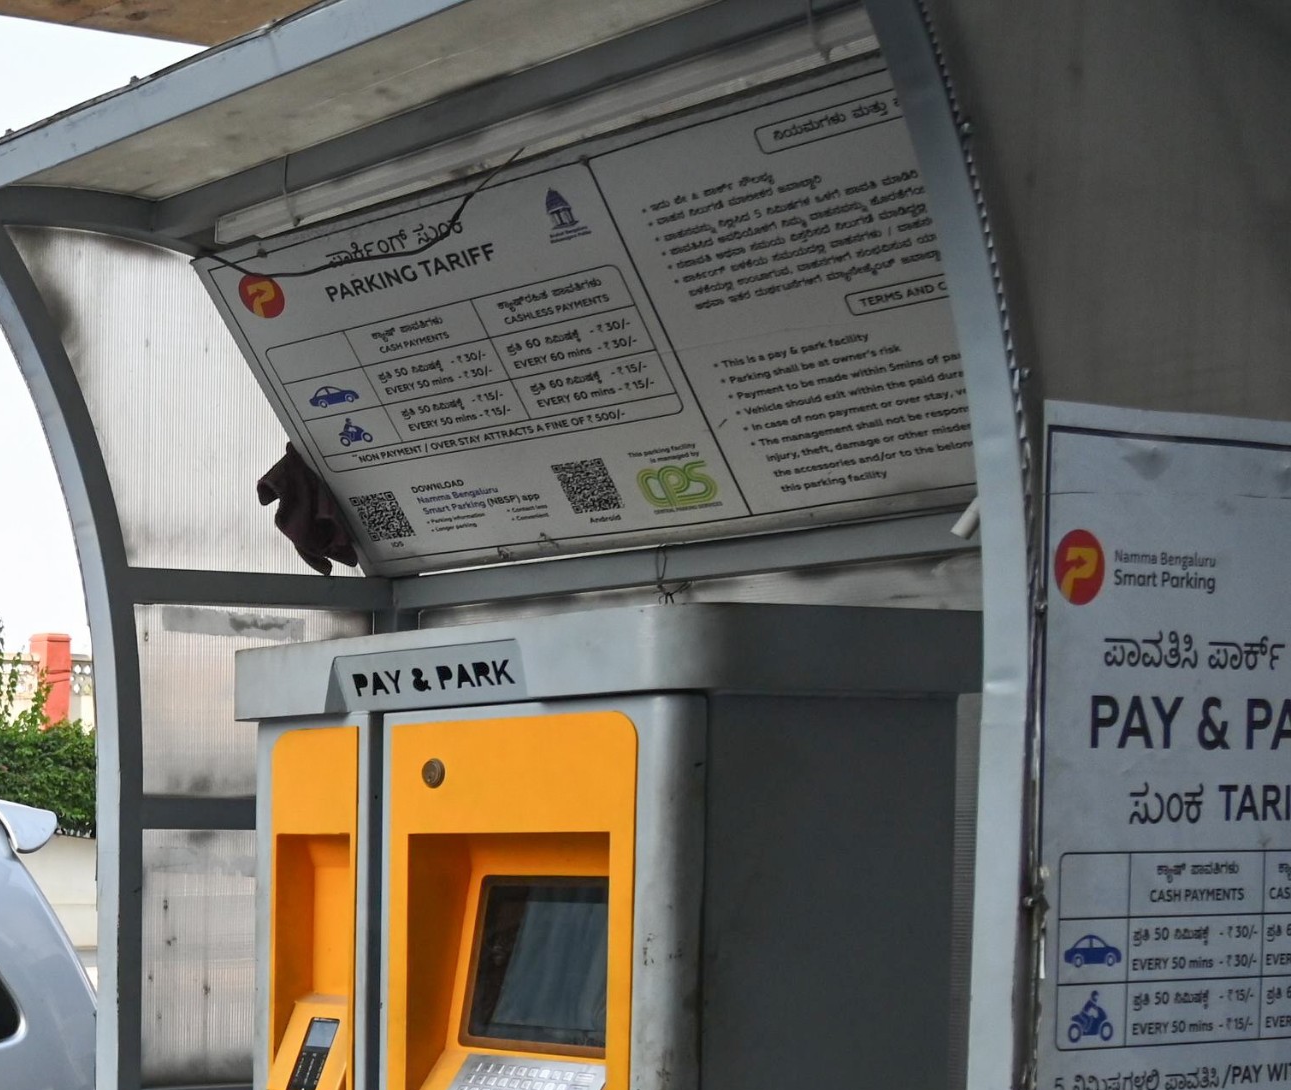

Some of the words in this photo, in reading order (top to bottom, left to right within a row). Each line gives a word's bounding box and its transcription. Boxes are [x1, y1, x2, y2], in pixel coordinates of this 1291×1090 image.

[325, 265, 417, 301] PARKING
[418, 243, 493, 276] TARIFF
[859, 291, 903, 305] TERMS
[906, 284, 934, 297] AND
[504, 307, 554, 324] CASHLESS
[555, 294, 609, 312] PAYMENTS
[379, 342, 403, 353] CASH
[403, 331, 449, 347] PAYMENTS
[721, 358, 745, 367] This
[746, 355, 756, 363] is
[767, 350, 786, 360] pay
[789, 346, 798, 354] &
[800, 341, 826, 353] park
[828, 334, 868, 346] facility
[513, 355, 546, 369] EVERY
[550, 351, 565, 361] 60
[567, 347, 592, 358] mins
[729, 371, 771, 383] Parking
[772, 364, 799, 375] shall
[800, 362, 815, 370] be
[818, 358, 830, 367] at
[879, 345, 900, 354] risk
[385, 382, 414, 395] EVERY
[416, 379, 430, 388] 50
[431, 376, 454, 385] mins
[736, 385, 784, 399] Payment
[799, 380, 814, 388] be
[816, 373, 848, 384] made
[850, 366, 886, 378] within
[926, 354, 938, 364] of
[536, 394, 570, 407] EVERY
[573, 391, 588, 400] 60
[590, 388, 616, 397] mins
[744, 403, 783, 414] Vehicle
[785, 394, 822, 408] should
[824, 391, 846, 400] exit
[848, 385, 884, 395] within
[886, 381, 906, 389] the
[908, 374, 935, 387] paid
[937, 371, 963, 380] dura
[764, 419, 788, 428] case
[790, 415, 801, 424] of
[804, 413, 826, 421] non
[828, 403, 878, 418] payment
[895, 396, 920, 406] over
[923, 391, 953, 401] stay,
[408, 419, 437, 431] EVERY
[440, 416, 453, 425] 50
[455, 414, 477, 423] mins
[781, 424, 853, 442] management
[856, 418, 883, 430] shall
[885, 415, 906, 424] not
[907, 413, 922, 421] be
[925, 406, 968, 417] respon
[380, 445, 421, 458] PAYMENT
[430, 439, 457, 450] OVER
[457, 435, 480, 445] STAY
[484, 425, 534, 440] ATTRACTS
[536, 424, 544, 432] A
[544, 419, 569, 430] FINE
[570, 416, 584, 426] OF
[835, 438, 880, 450] damage
[882, 435, 894, 443] or
[897, 430, 928, 440] other
[643, 447, 670, 457] parking
[670, 443, 696, 451] facility
[657, 452, 689, 461] managed
[773, 469, 791, 477] the
[794, 459, 856, 473] accessories
[859, 452, 896, 463] and/or
[914, 446, 934, 454] the
[411, 479, 464, 493] DOWNLOAD
[780, 483, 801, 492] this
[803, 477, 846, 490] parking
[847, 471, 886, 481] facility
[416, 494, 451, 503] Namma
[451, 488, 498, 498] Bengaluru
[422, 505, 450, 514] Smart
[451, 501, 486, 510] Parking
[487, 495, 520, 507] (NBSP)
[522, 493, 540, 501] app
[590, 514, 621, 523] Android
[1115, 549, 1157, 565] Namma
[1160, 552, 1217, 570] Bengaluru
[1114, 569, 1157, 588] Smart
[1161, 571, 1216, 594] Parking
[1104, 630, 1198, 669] ಪಾವತಿಸಿ
[1208, 634, 1286, 670] ಪಾರ್ಕ್
[351, 669, 401, 697] PAY
[411, 667, 431, 692] &
[436, 659, 516, 690] PARK
[1090, 695, 1184, 749] PAY
[1197, 697, 1230, 750] &
[1246, 698, 1291, 750] PA
[1129, 781, 1204, 824] ಸುಂಕ
[1218, 784, 1291, 821] TARI
[1150, 889, 1181, 903] CASH
[1184, 887, 1244, 901] PAYMENTS
[1132, 958, 1168, 971] EVERY
[1171, 956, 1185, 969] 50
[1189, 956, 1213, 968] mins
[1132, 1022, 1168, 1036] EVERY
[1171, 1021, 1186, 1034] 50
[1189, 1020, 1213, 1032] mins
